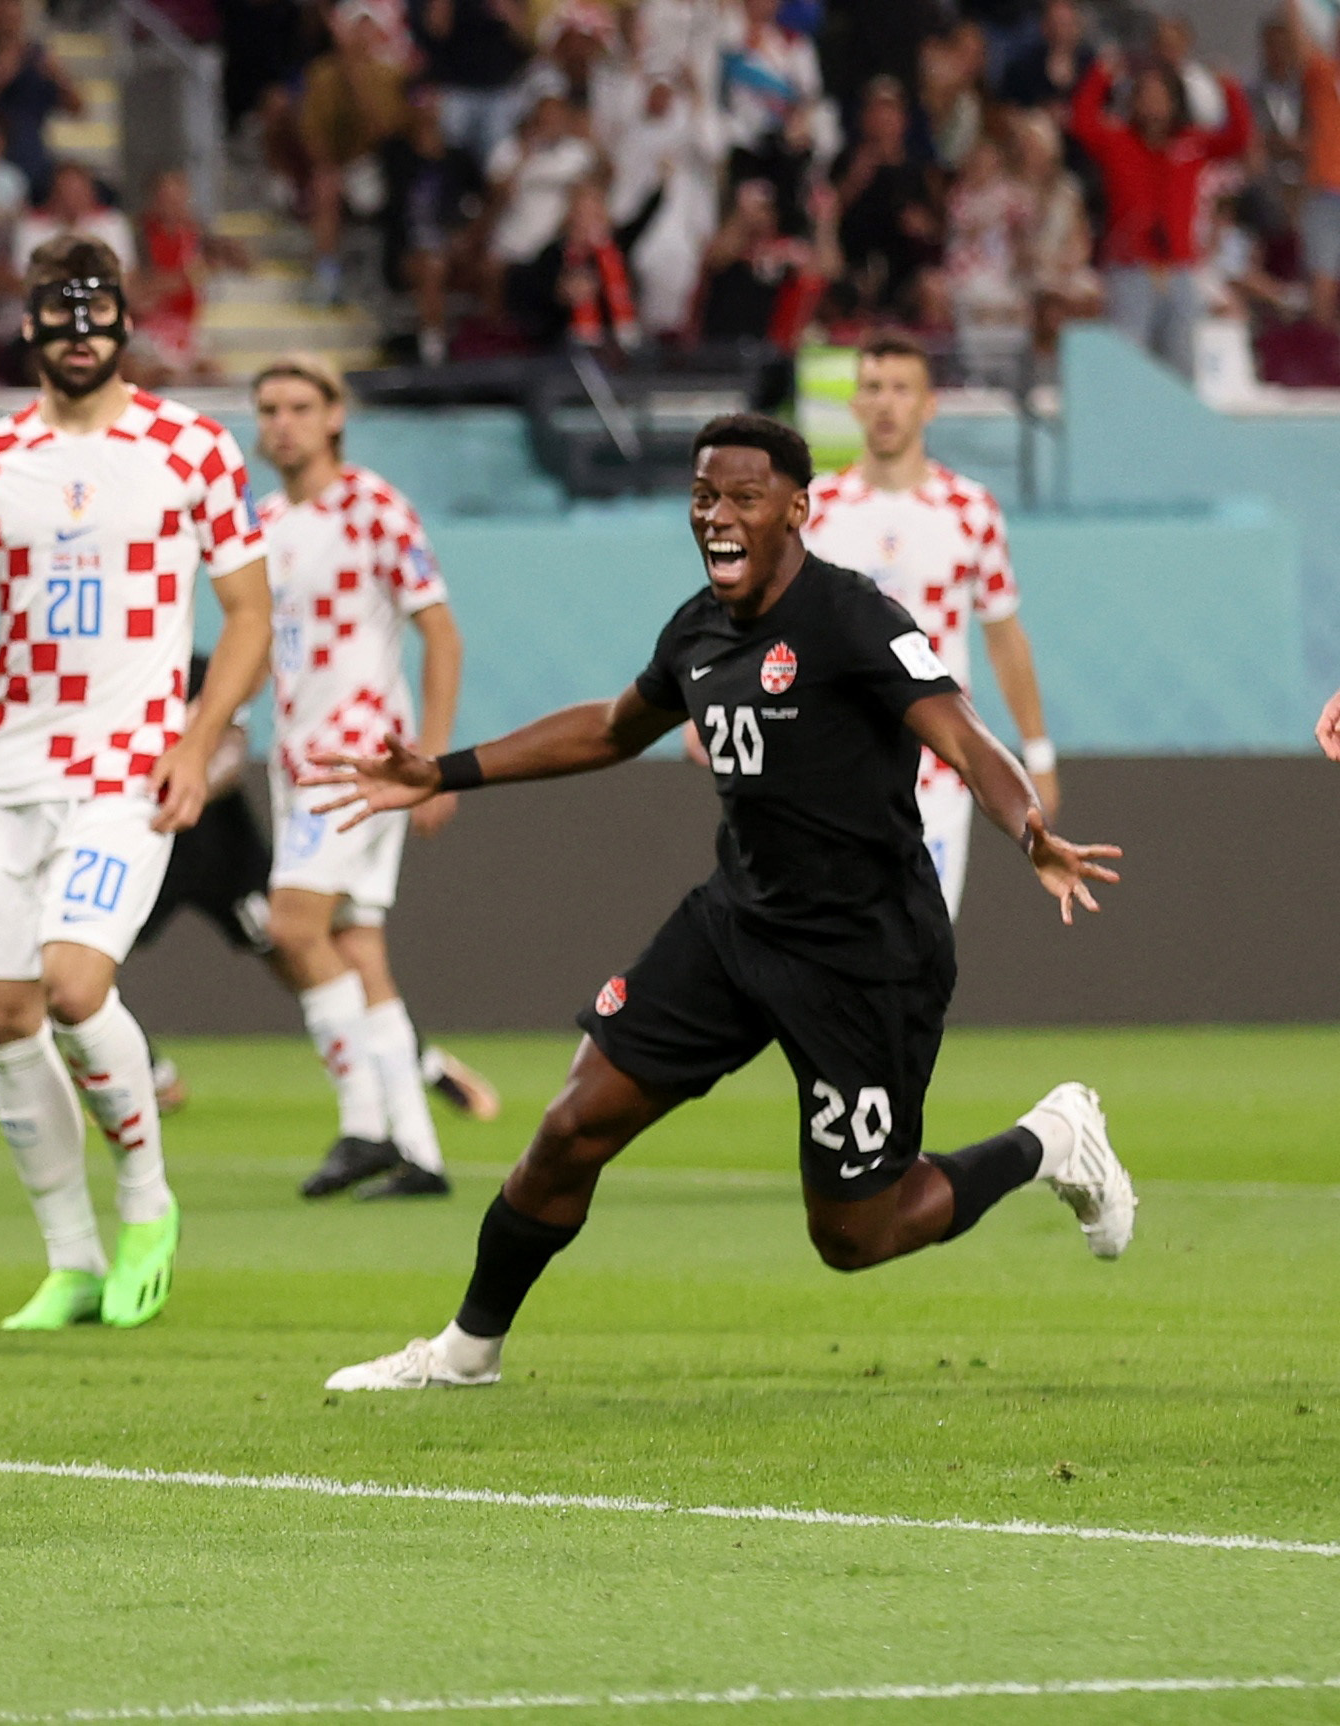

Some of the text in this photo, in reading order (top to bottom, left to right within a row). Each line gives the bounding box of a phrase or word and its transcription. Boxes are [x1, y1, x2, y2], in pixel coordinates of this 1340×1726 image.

[48, 578, 101, 637] 20
[704, 704, 764, 775] 20
[63, 849, 127, 912] 20
[810, 1078, 892, 1153] 20
